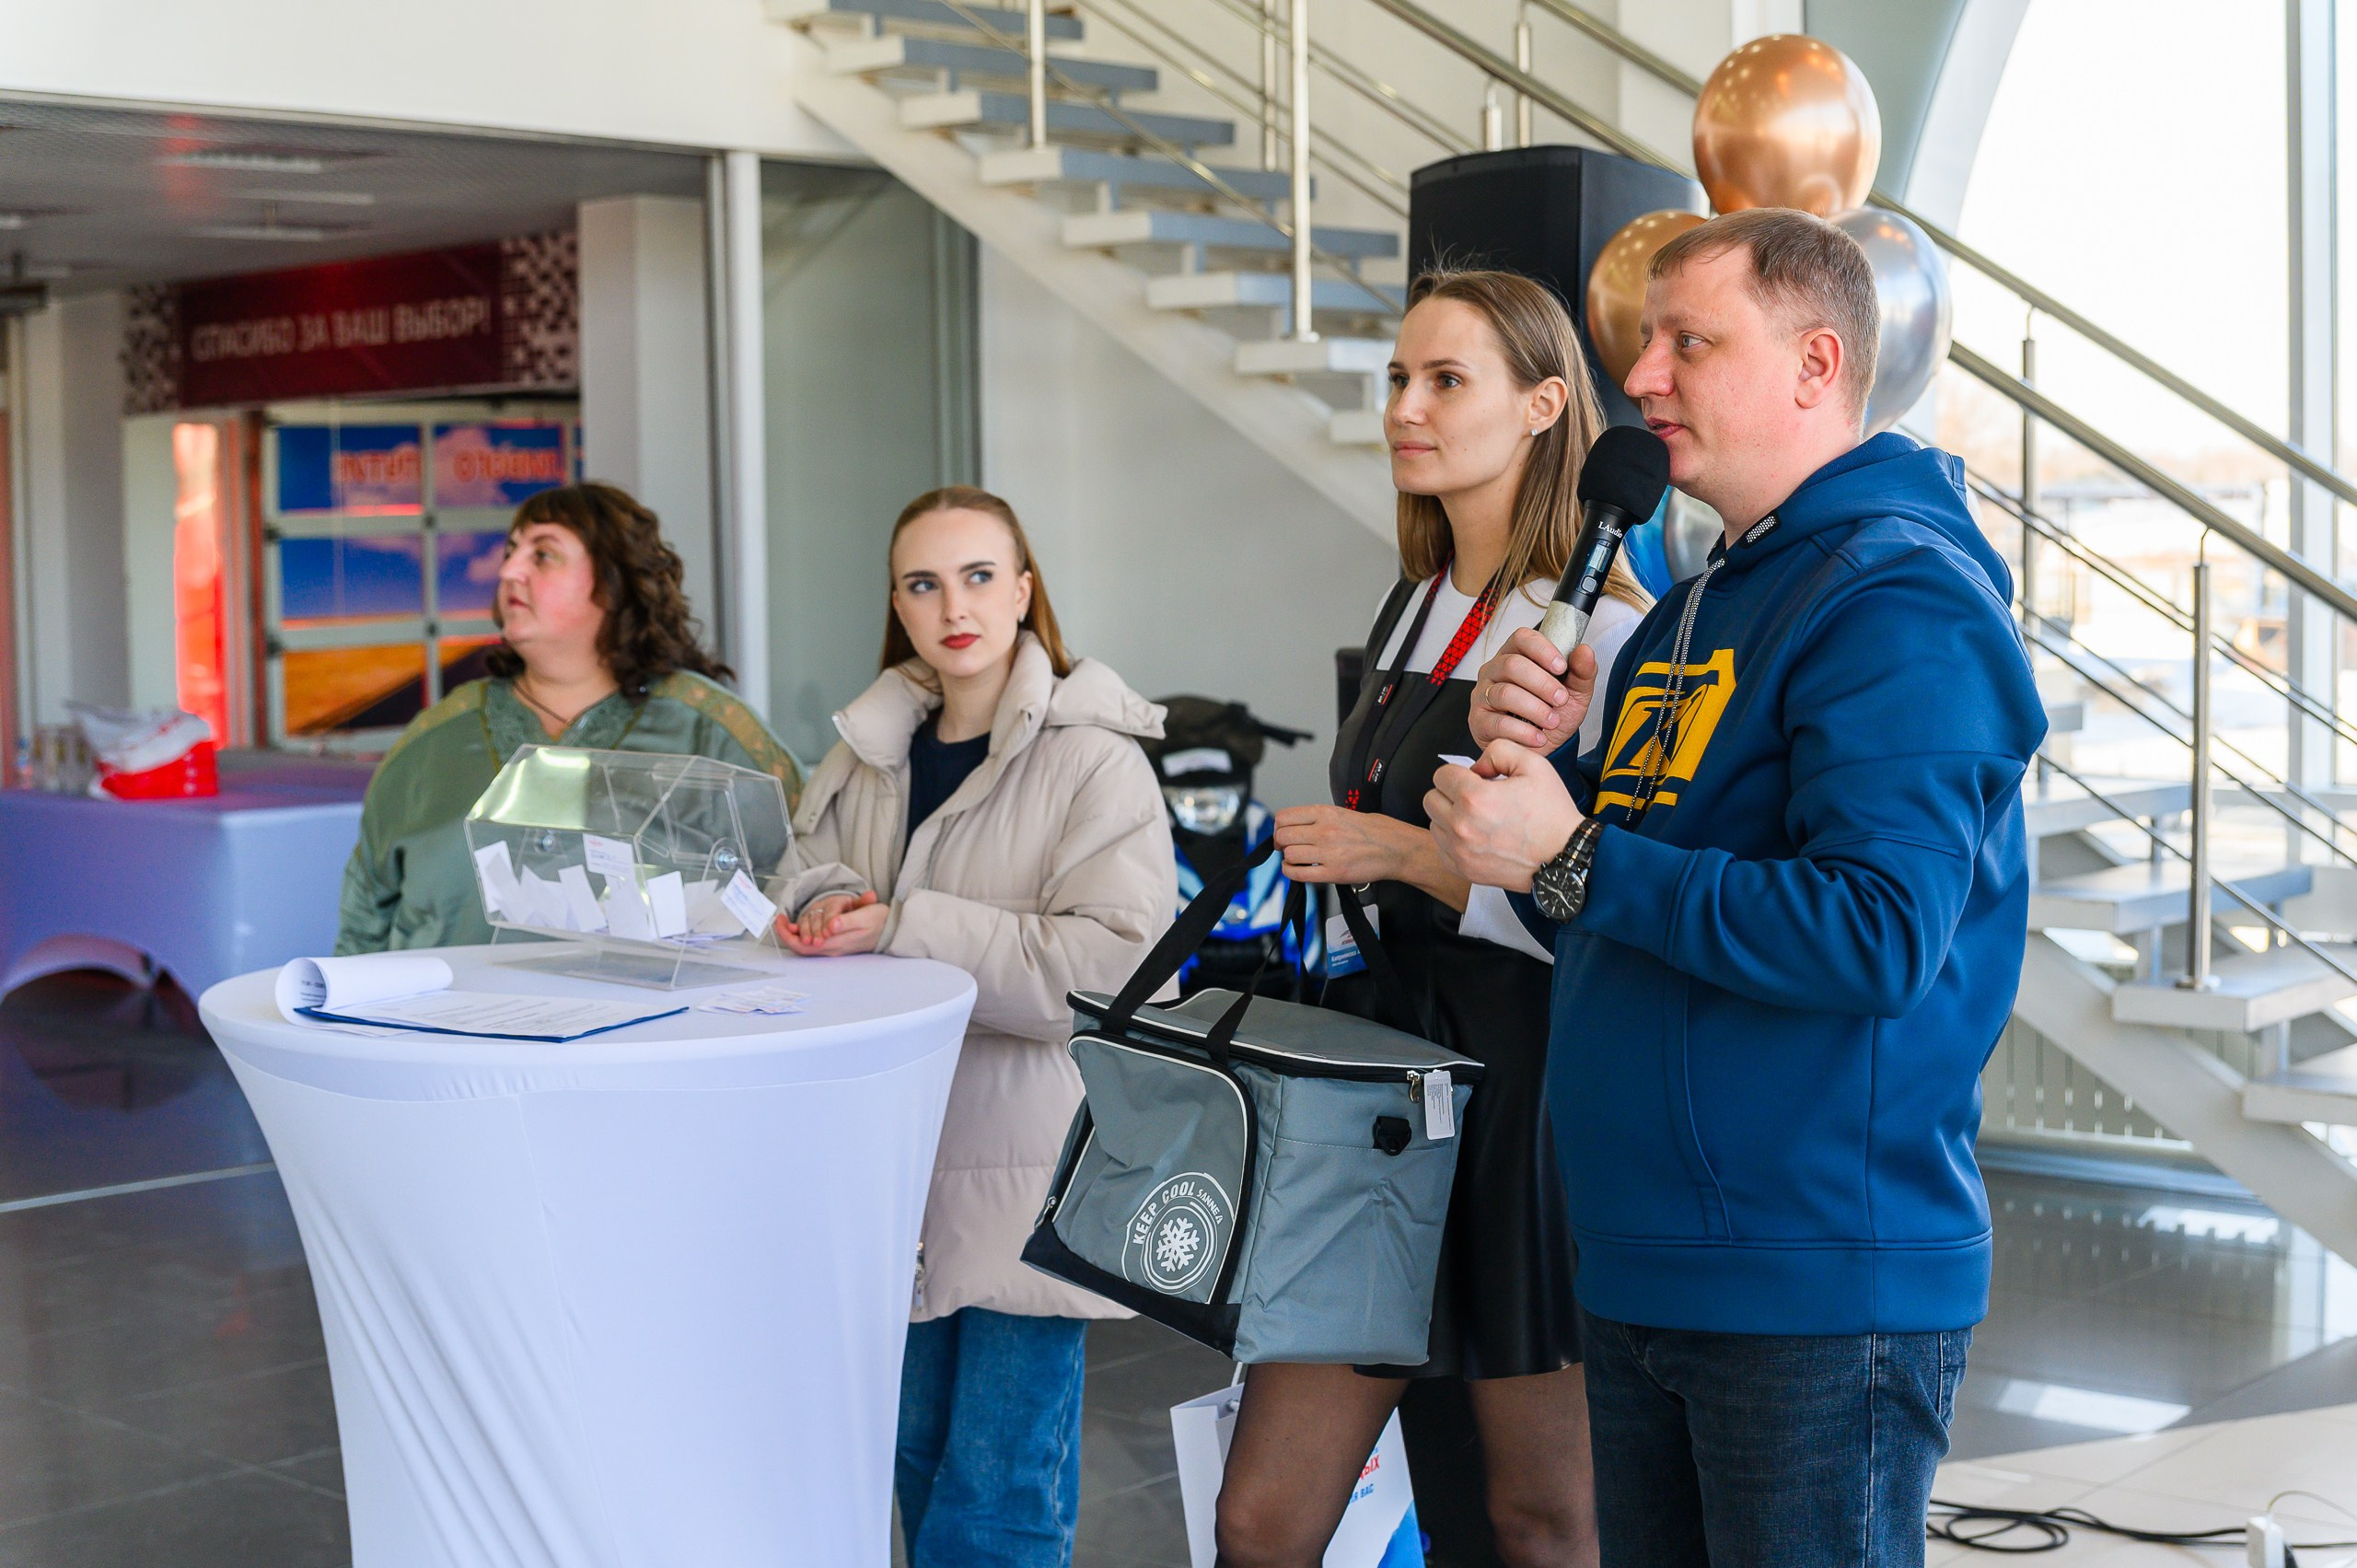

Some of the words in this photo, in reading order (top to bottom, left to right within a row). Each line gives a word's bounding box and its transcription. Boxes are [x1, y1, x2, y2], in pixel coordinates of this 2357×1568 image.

[192, 316, 296, 362] СПАСИБО
[296, 313, 330, 353] ЗА
[331, 308, 390, 348] ВАШ
[393, 296, 492, 343] ВЫБОР!
[1598, 521, 1623, 539] LAudio
[1132, 1202, 1157, 1245] KEEP
[1162, 1181, 1195, 1204] COOL
